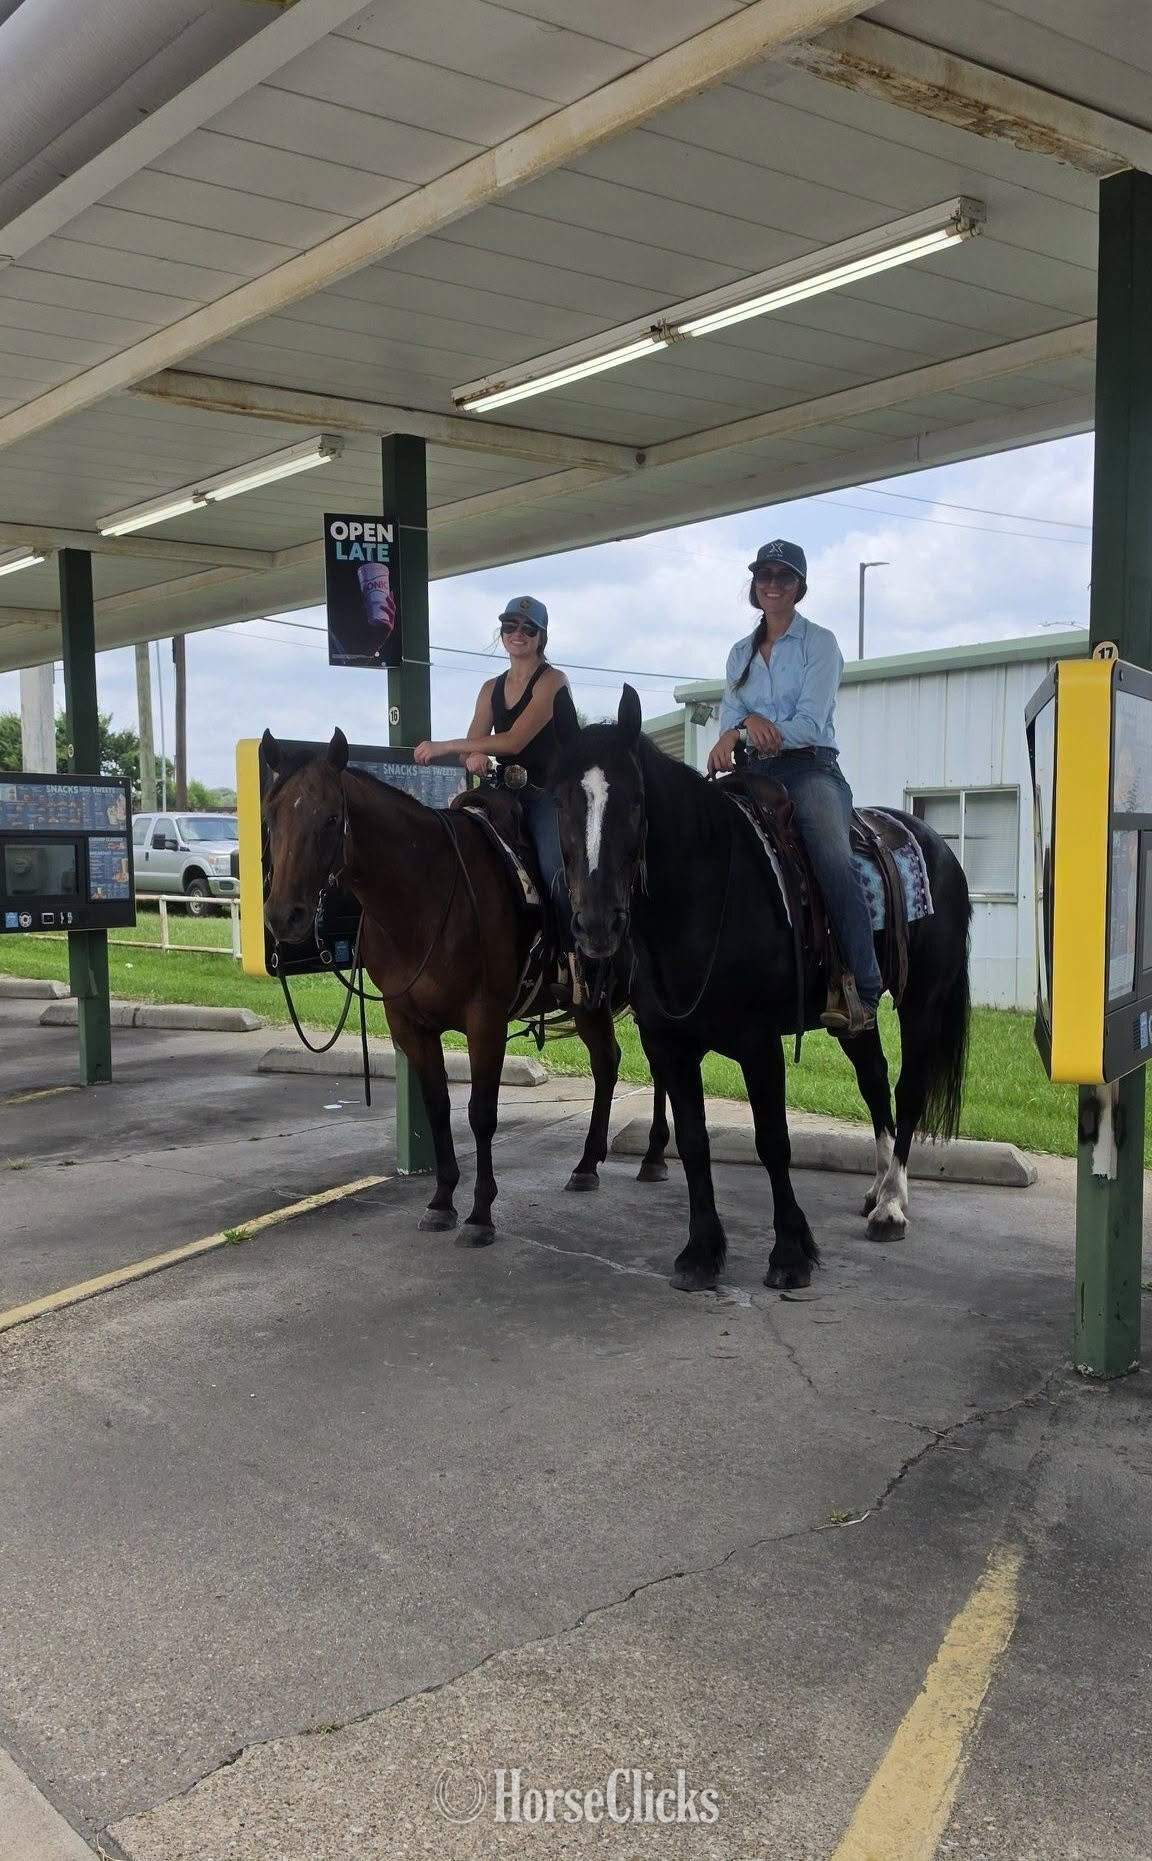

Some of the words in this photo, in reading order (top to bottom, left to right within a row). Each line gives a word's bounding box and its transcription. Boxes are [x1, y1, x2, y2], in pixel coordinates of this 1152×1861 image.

[330, 521, 393, 543] OPEN
[336, 542, 390, 562] LATE
[1098, 646, 1114, 659] 17
[391, 710, 398, 721] 16
[383, 764, 418, 776] SNACKS
[46, 785, 79, 794] SNACKS
